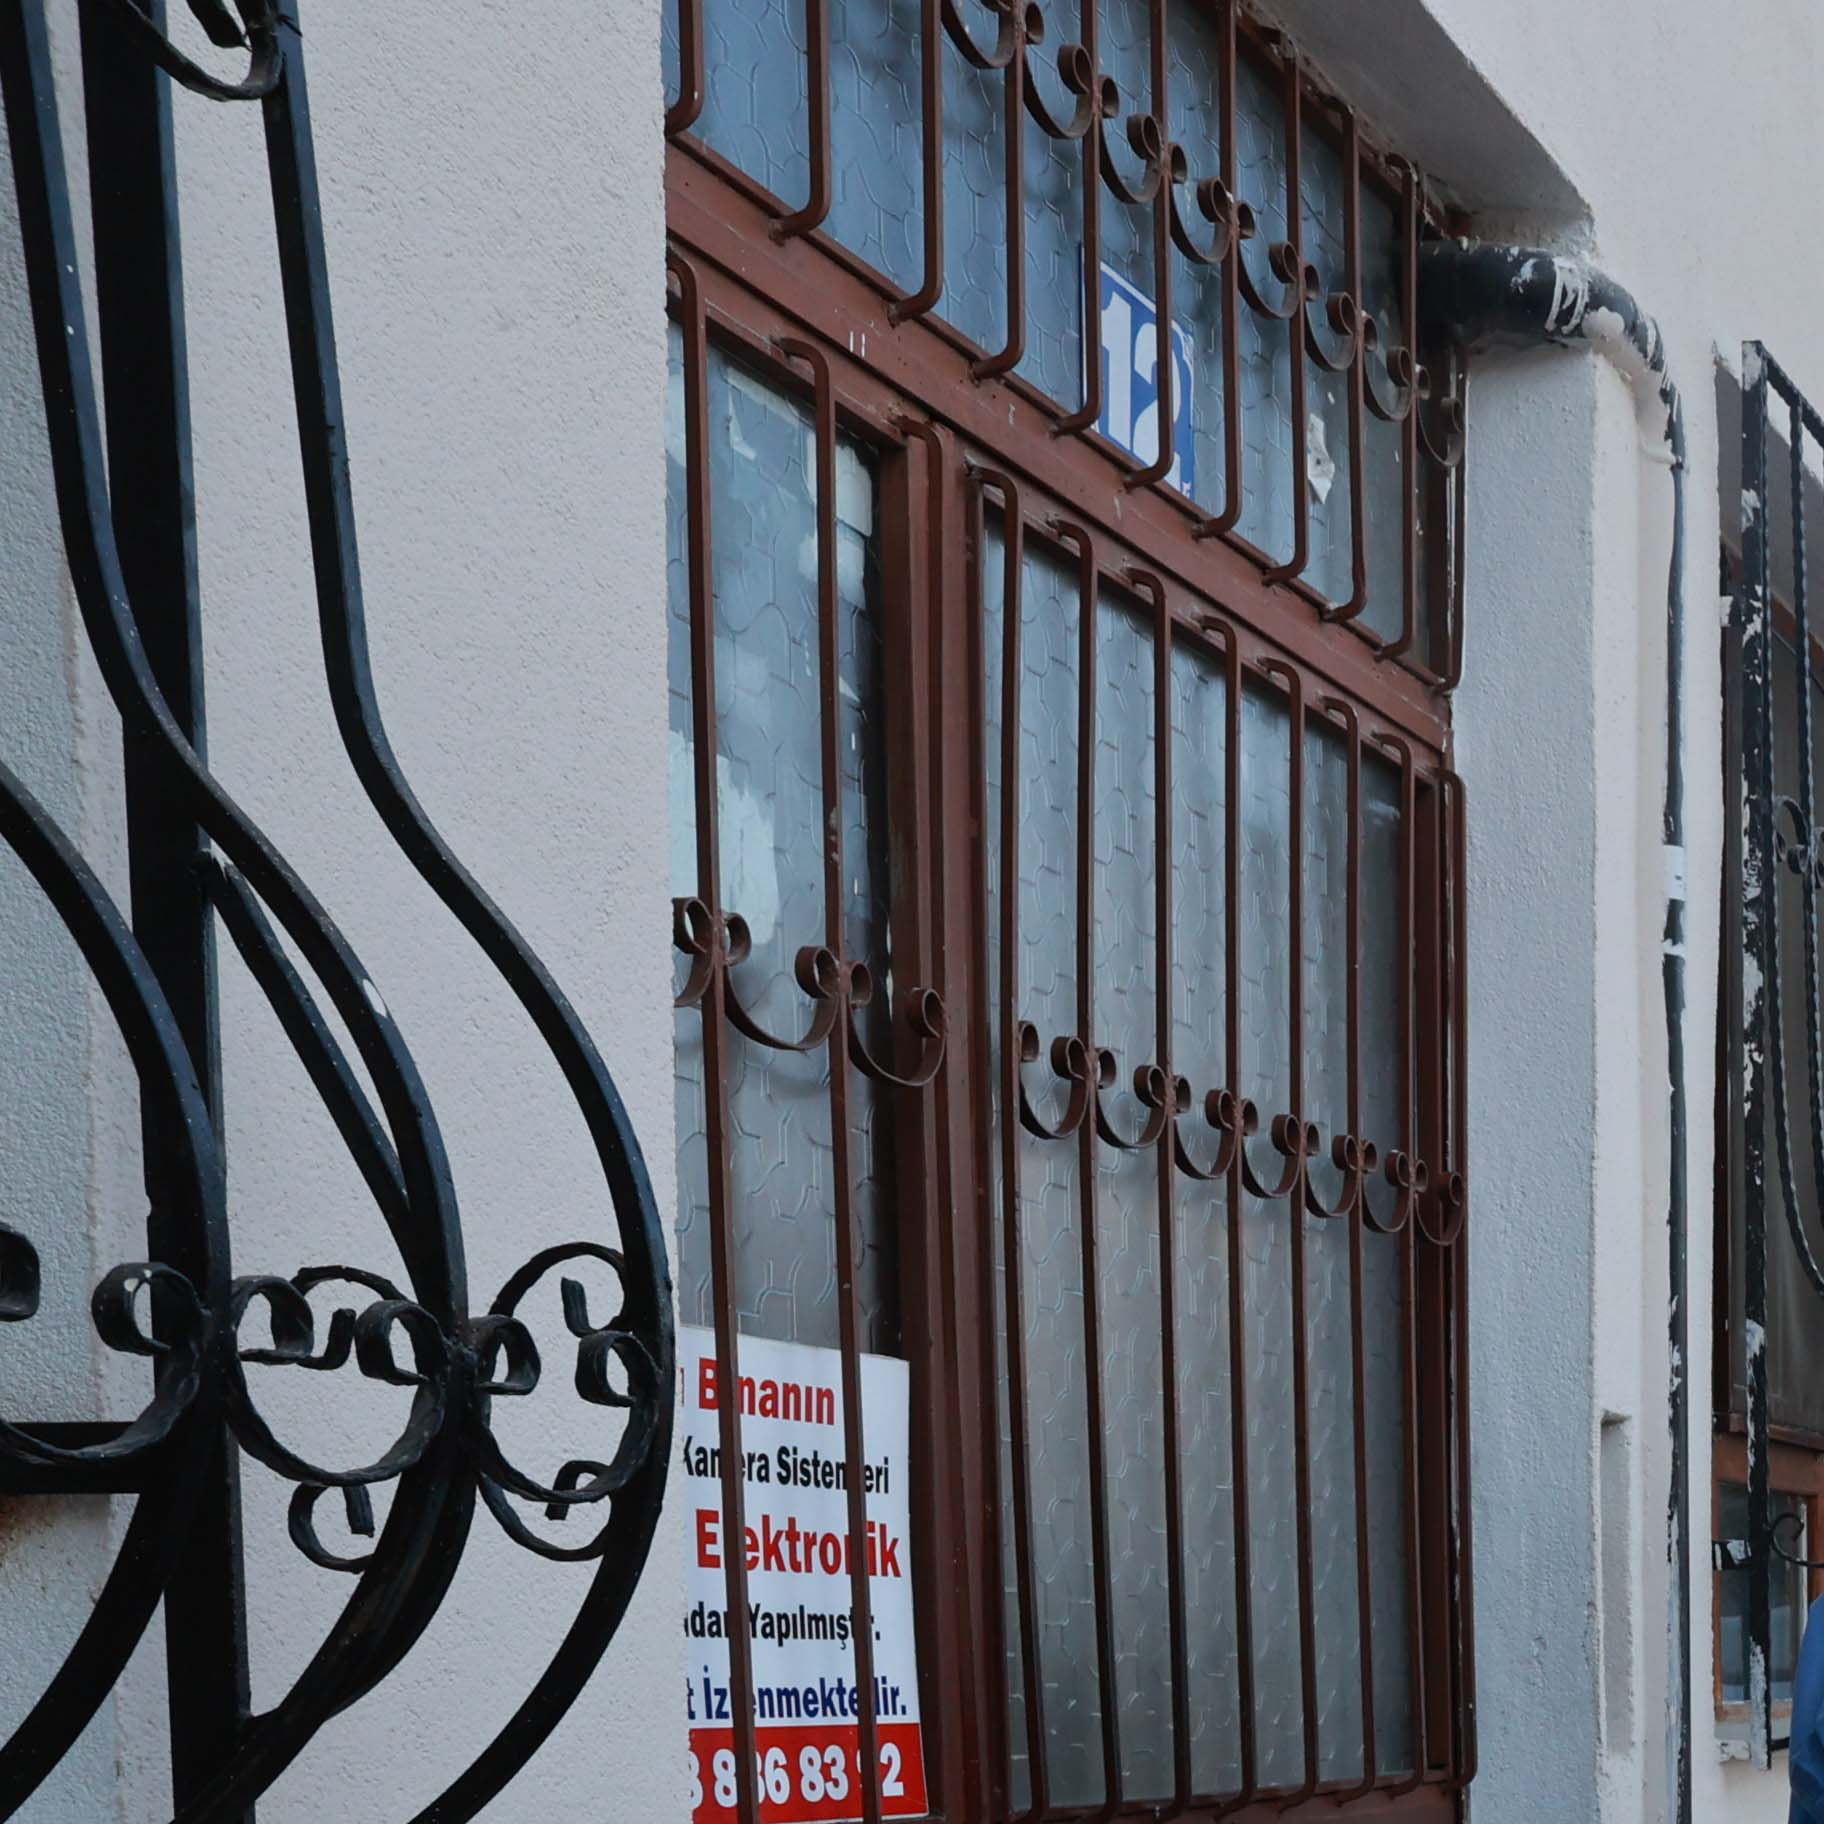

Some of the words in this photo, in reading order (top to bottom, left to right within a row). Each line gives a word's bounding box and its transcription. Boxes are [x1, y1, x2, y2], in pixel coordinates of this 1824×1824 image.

[1101, 294, 1181, 493] 12
[698, 1357, 835, 1425] Bnanın
[776, 1445, 889, 1494] Sistemeri
[696, 1508, 902, 1578] Eektroik
[712, 1746, 791, 1808] 86
[800, 1744, 849, 1803] 83
